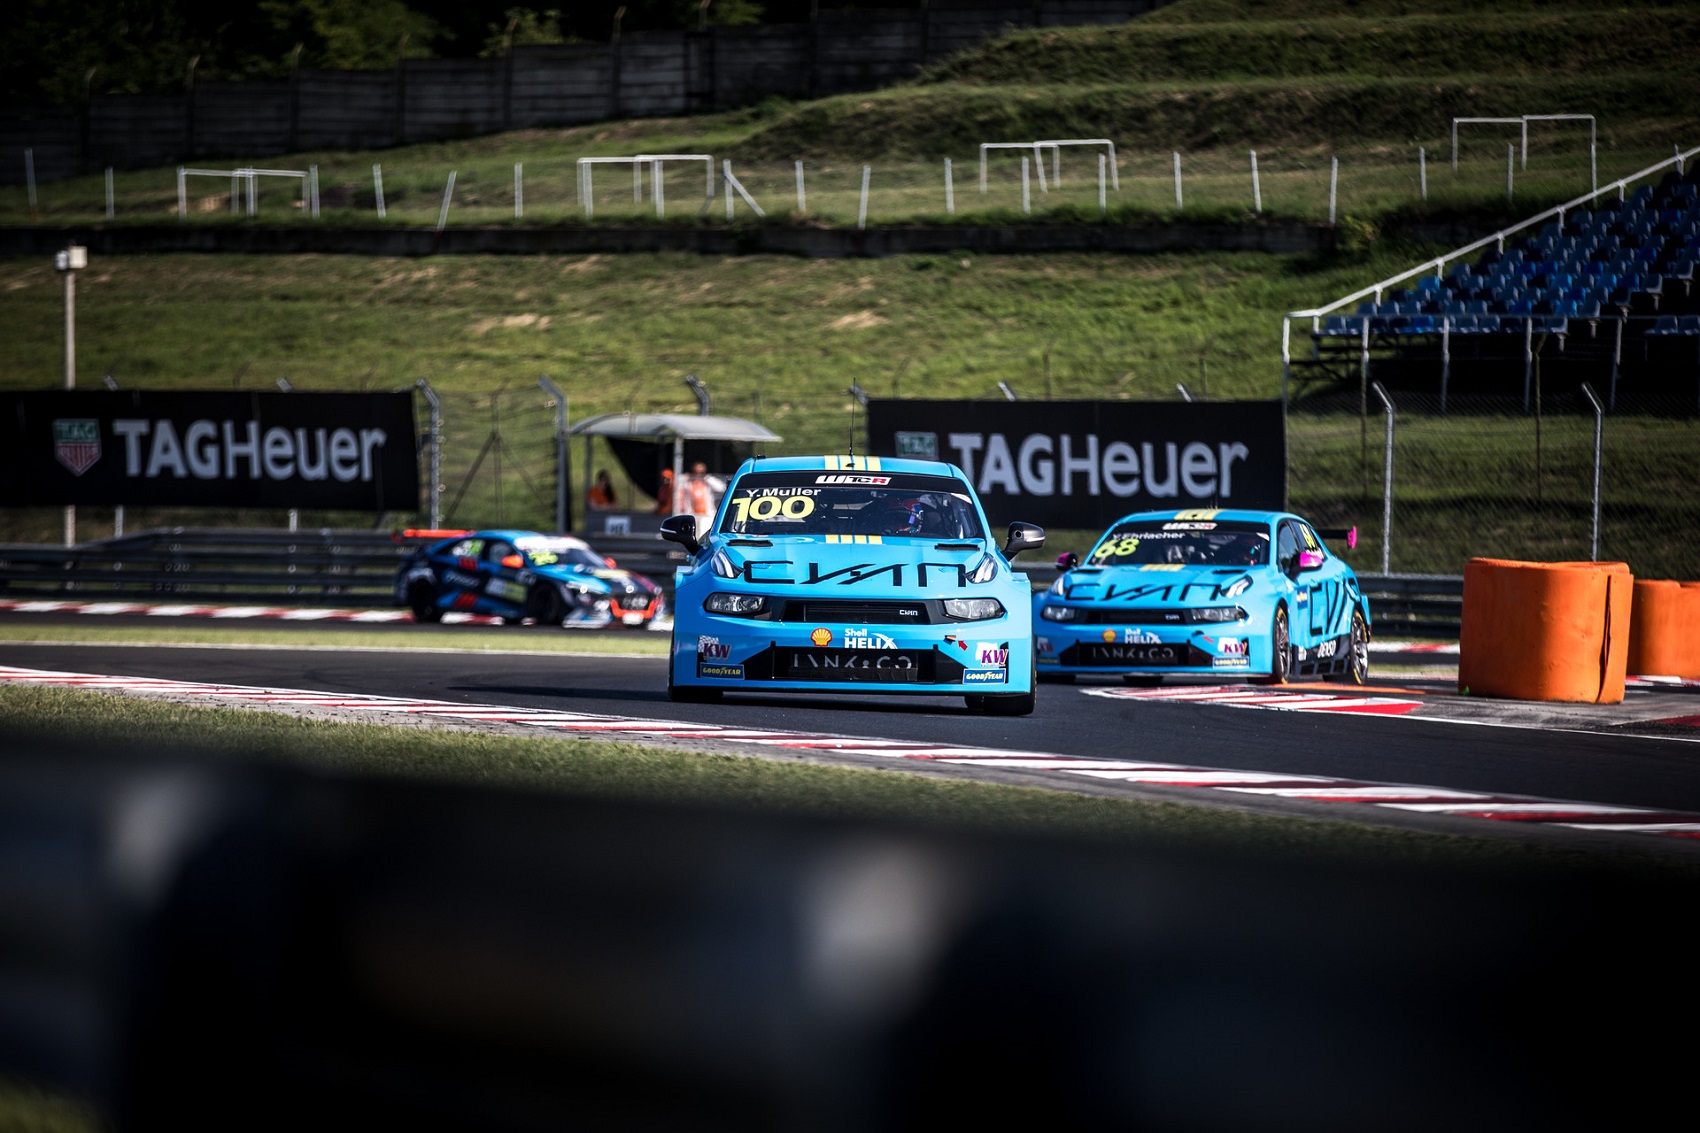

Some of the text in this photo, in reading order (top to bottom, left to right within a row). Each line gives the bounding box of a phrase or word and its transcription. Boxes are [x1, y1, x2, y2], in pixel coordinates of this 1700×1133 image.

[732, 496, 815, 522] 100
[1094, 538, 1140, 558] 68
[844, 628, 867, 636] Shell
[1125, 632, 1162, 644] HELIX
[844, 633, 898, 649] HELIX
[703, 644, 731, 659] KW
[981, 649, 1008, 664] KW
